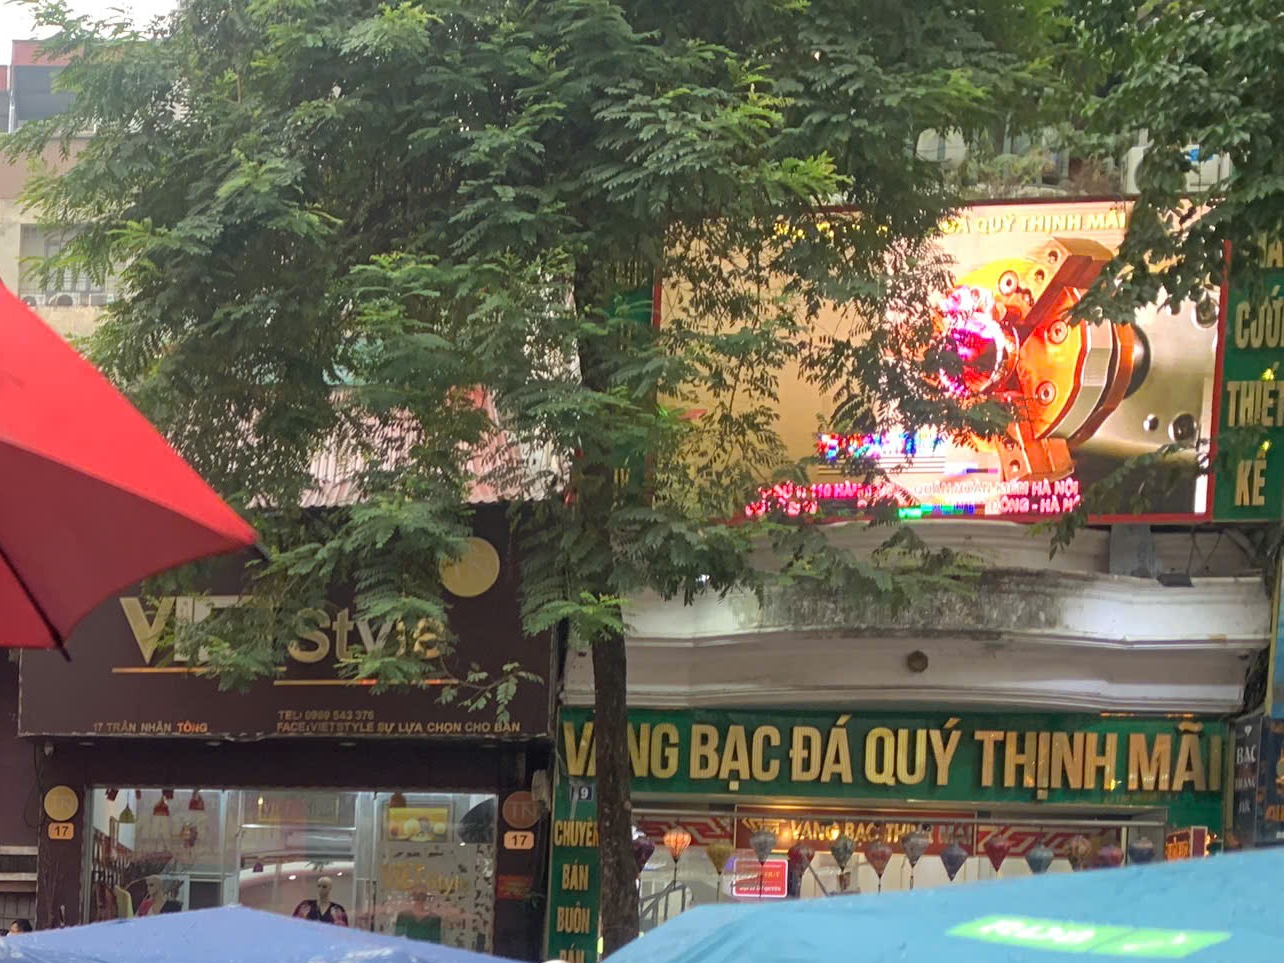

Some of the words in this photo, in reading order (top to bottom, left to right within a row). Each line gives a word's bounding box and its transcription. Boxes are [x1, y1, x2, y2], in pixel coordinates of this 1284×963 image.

[177, 720, 209, 732] TÔNG
[465, 722, 491, 732] CHO
[564, 721, 680, 778] VNG
[689, 724, 781, 791] BẠC
[789, 714, 853, 783] ĐÁ
[865, 717, 962, 786] QUÝ
[974, 730, 1118, 800] THỊNH
[1127, 721, 1222, 792] MÃI
[55, 826, 69, 837] 17
[510, 835, 527, 846] 17
[561, 859, 589, 891] BÁN
[556, 901, 590, 933] BUÔN
